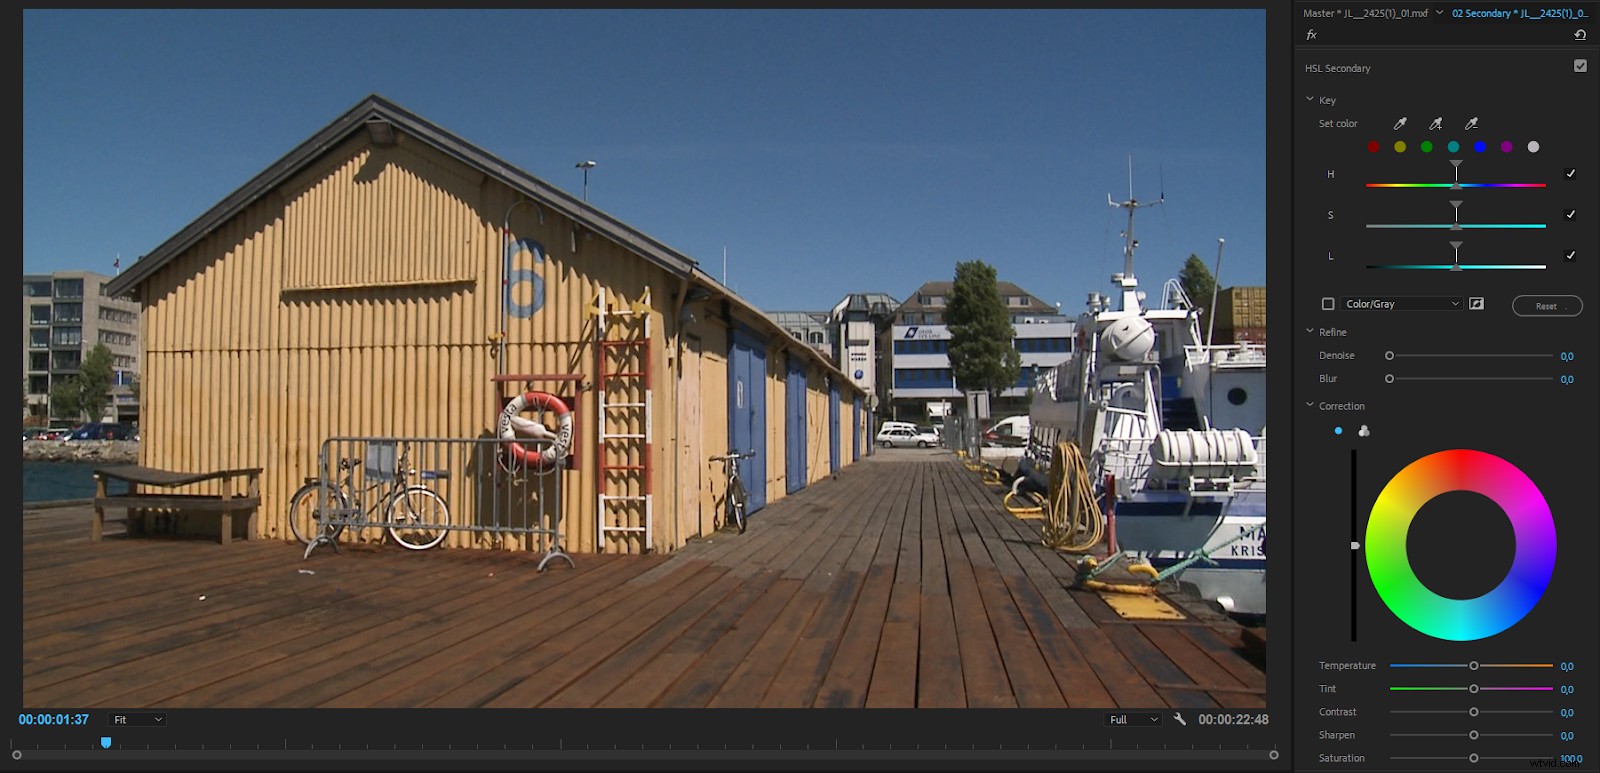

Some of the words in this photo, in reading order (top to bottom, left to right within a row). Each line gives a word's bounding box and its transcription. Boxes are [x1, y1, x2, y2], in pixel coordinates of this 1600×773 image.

[1303, 9, 1335, 18] Master
[1451, 9, 1464, 18] 02
[1466, 9, 1512, 20] Secondary
[1305, 64, 1324, 73] HSL
[1326, 64, 1371, 75] Secondary
[1319, 96, 1337, 107] Key
[1319, 119, 1334, 128] Set
[1335, 119, 1358, 128] color
[1327, 170, 1335, 179] H
[1327, 211, 1334, 220] S
[1328, 252, 1334, 261] L
[507, 237, 545, 318] 6
[1346, 299, 1396, 310] Color/Gray
[1536, 302, 1558, 310] Reset
[1319, 327, 1347, 337] Refine
[1319, 351, 1355, 360] Denoise
[1560, 351, 1575, 363] 0,0
[1319, 374, 1338, 383] Blur
[1560, 375, 1575, 386] 0,0
[1319, 401, 1366, 411] Correction
[1318, 661, 1377, 672] Temperature
[1560, 662, 1575, 673] 0,0
[1318, 684, 1337, 693] Tint
[1560, 685, 1575, 696] 0,0
[1319, 707, 1357, 717] Contrast
[1560, 708, 1575, 719] 0,0
[18, 713, 90, 726] 00:00:01:37
[114, 715, 127, 725] Fit
[1110, 715, 1128, 725] Full
[1198, 713, 1270, 725] 00:00:22:48
[1319, 731, 1356, 741] Sharpen
[1560, 731, 1575, 742] 0,0
[1319, 753, 1366, 763] Saturation
